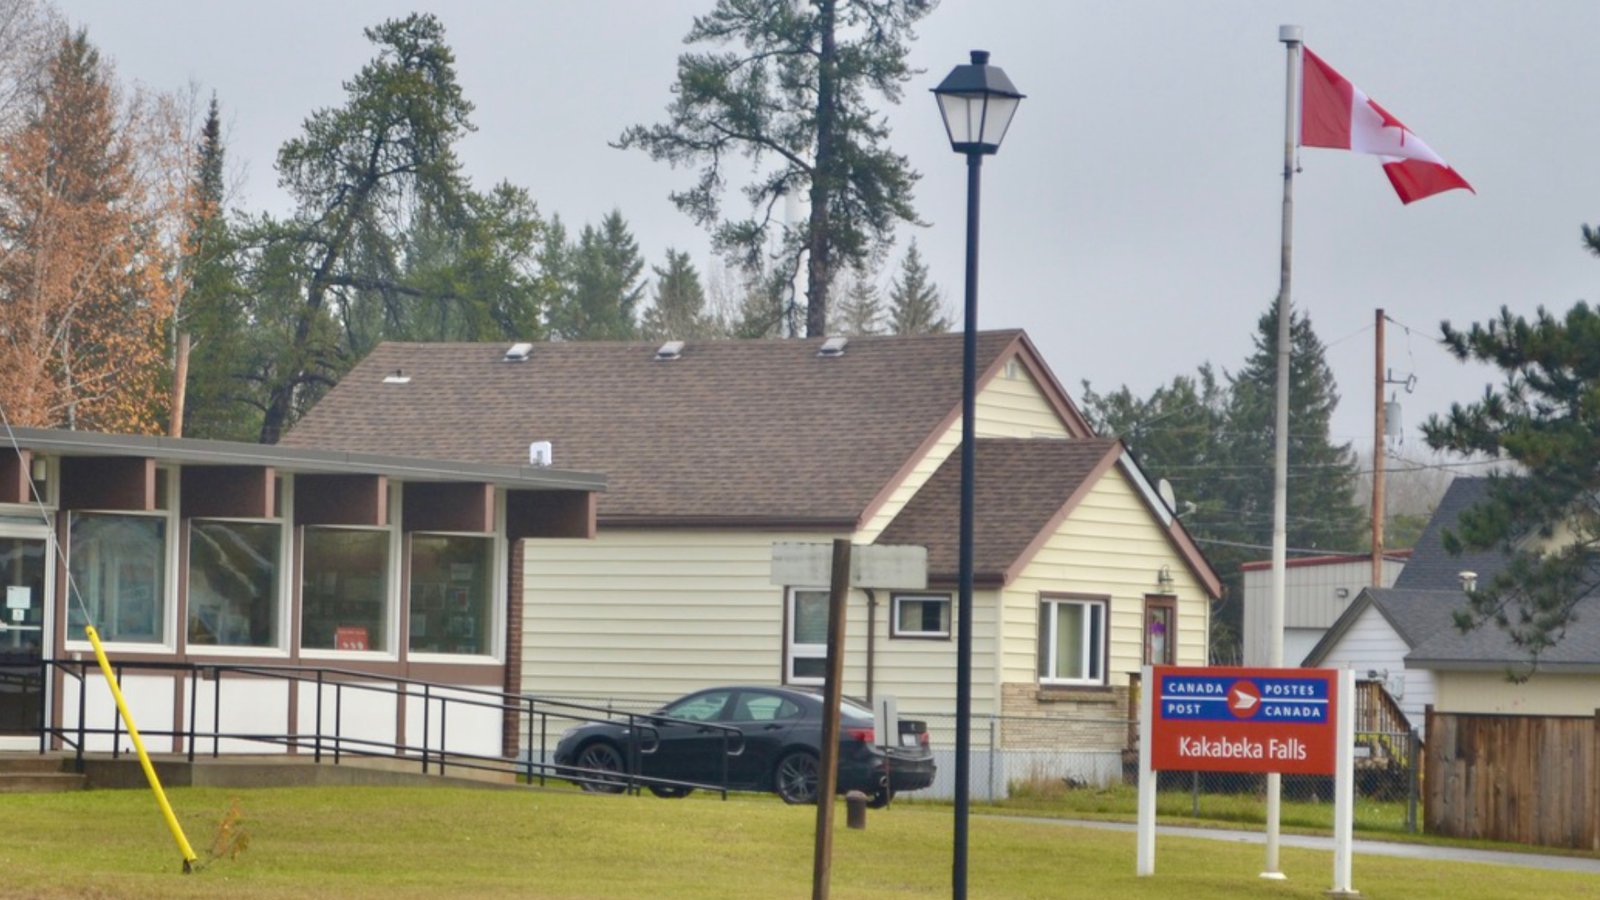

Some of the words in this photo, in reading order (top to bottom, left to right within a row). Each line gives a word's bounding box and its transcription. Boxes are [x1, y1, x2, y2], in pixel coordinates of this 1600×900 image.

[1168, 682, 1224, 694] CANADA
[1265, 684, 1315, 696] POSTES
[1168, 703, 1202, 714] POST
[1264, 705, 1321, 718] CANADA
[1179, 736, 1263, 759] Kakabeka
[1269, 738, 1307, 760] Falls
